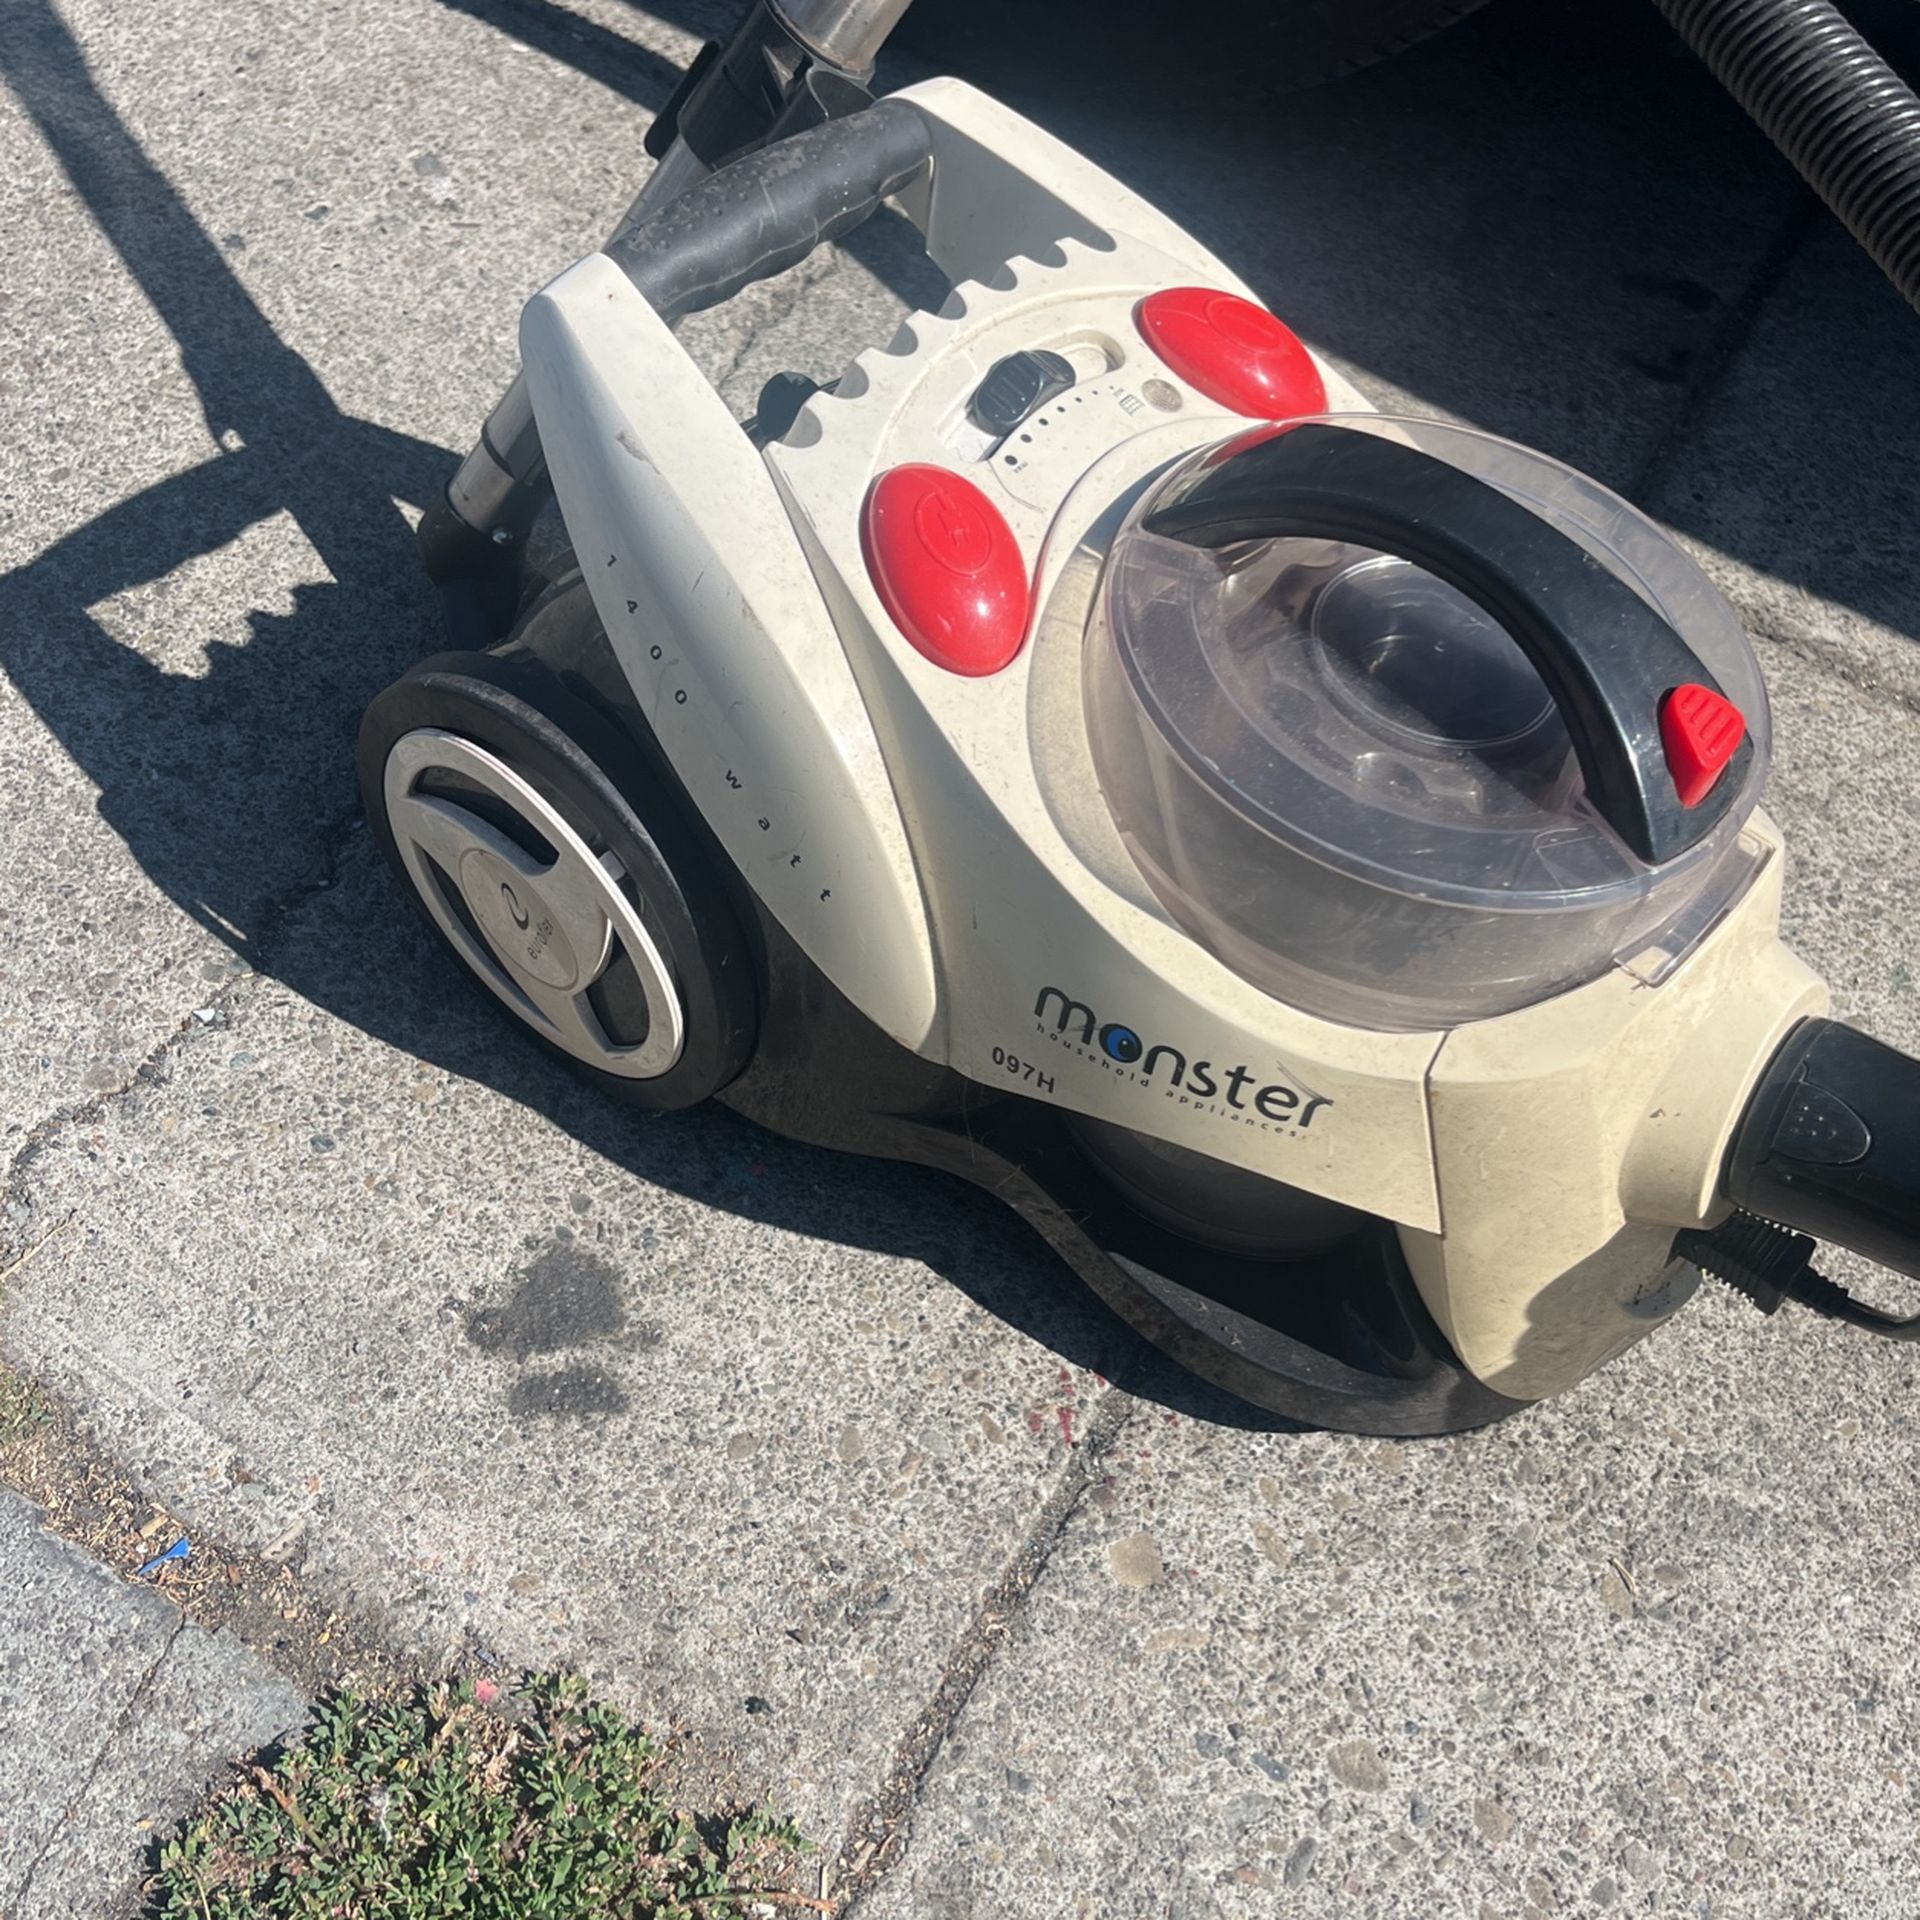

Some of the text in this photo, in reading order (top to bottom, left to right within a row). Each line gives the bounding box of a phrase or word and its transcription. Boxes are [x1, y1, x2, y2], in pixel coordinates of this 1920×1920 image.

[606, 554, 832, 902] 1400 watt
[991, 1046, 1055, 1094] 097H
[1033, 986, 1335, 1128] monster
[1036, 1022, 1296, 1137] household appliances
